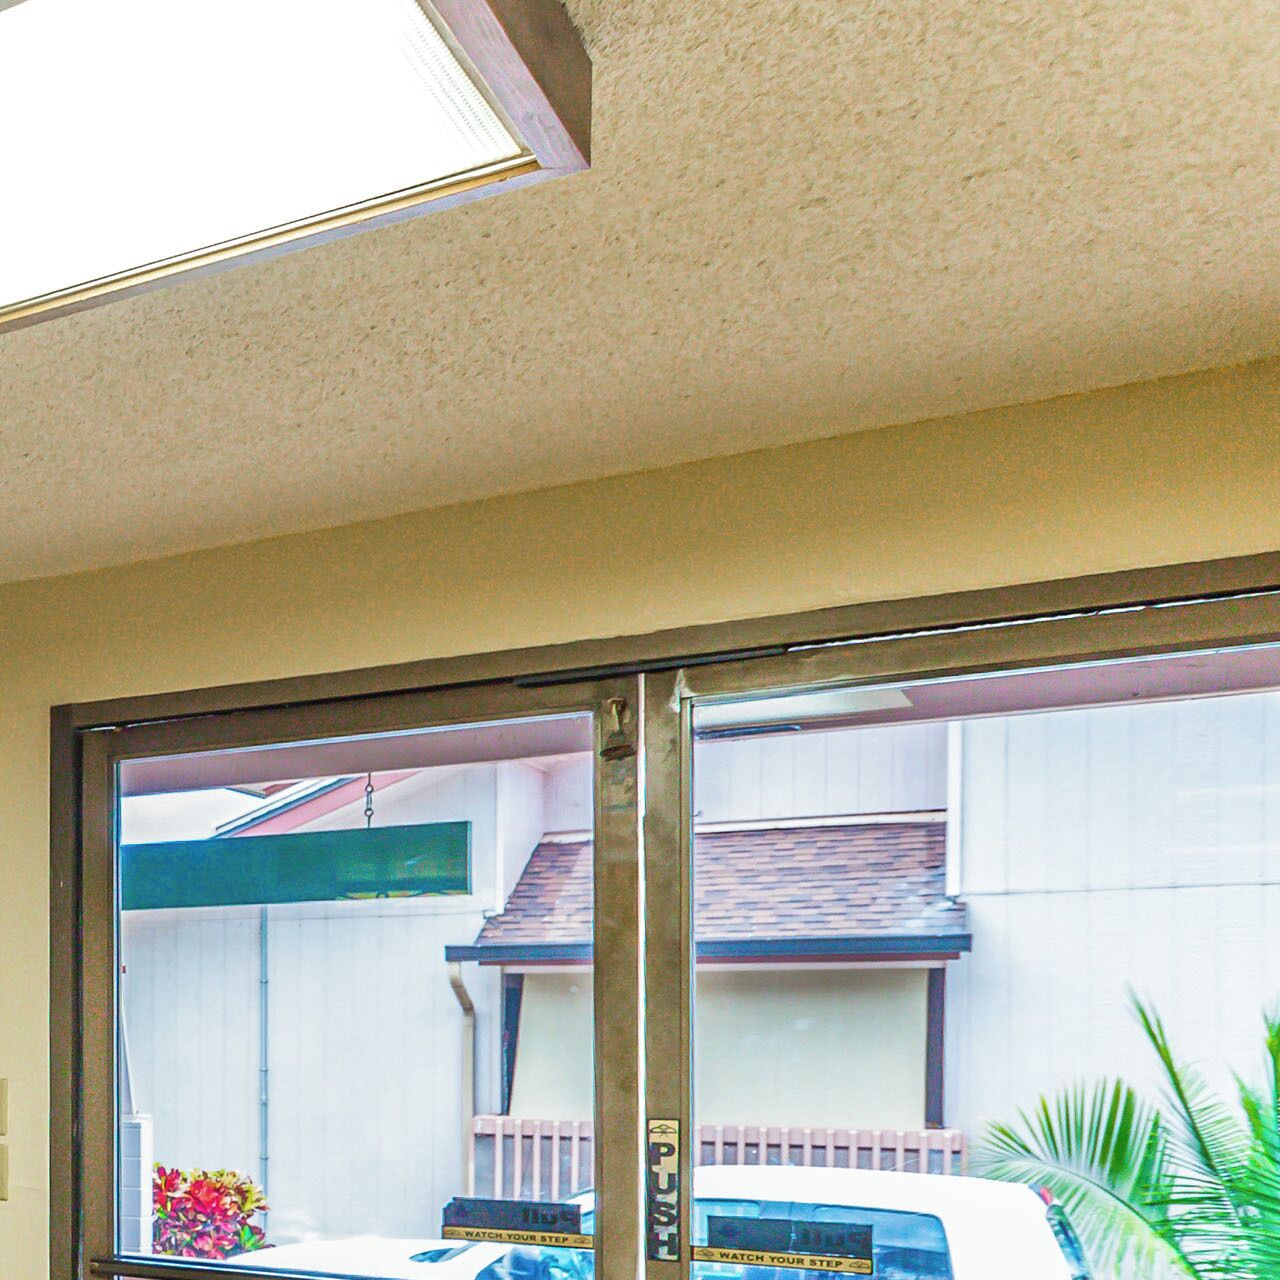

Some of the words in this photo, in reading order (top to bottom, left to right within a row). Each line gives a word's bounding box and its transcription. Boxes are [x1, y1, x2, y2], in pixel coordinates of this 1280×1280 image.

[649, 1141, 679, 1260] PUSH
[464, 1231, 503, 1240] WATCH
[506, 1233, 537, 1242] YOUR
[540, 1235, 570, 1244] STEP
[719, 1251, 765, 1263] WATCH
[768, 1254, 805, 1266] YOUR
[809, 1258, 843, 1269] STEP
